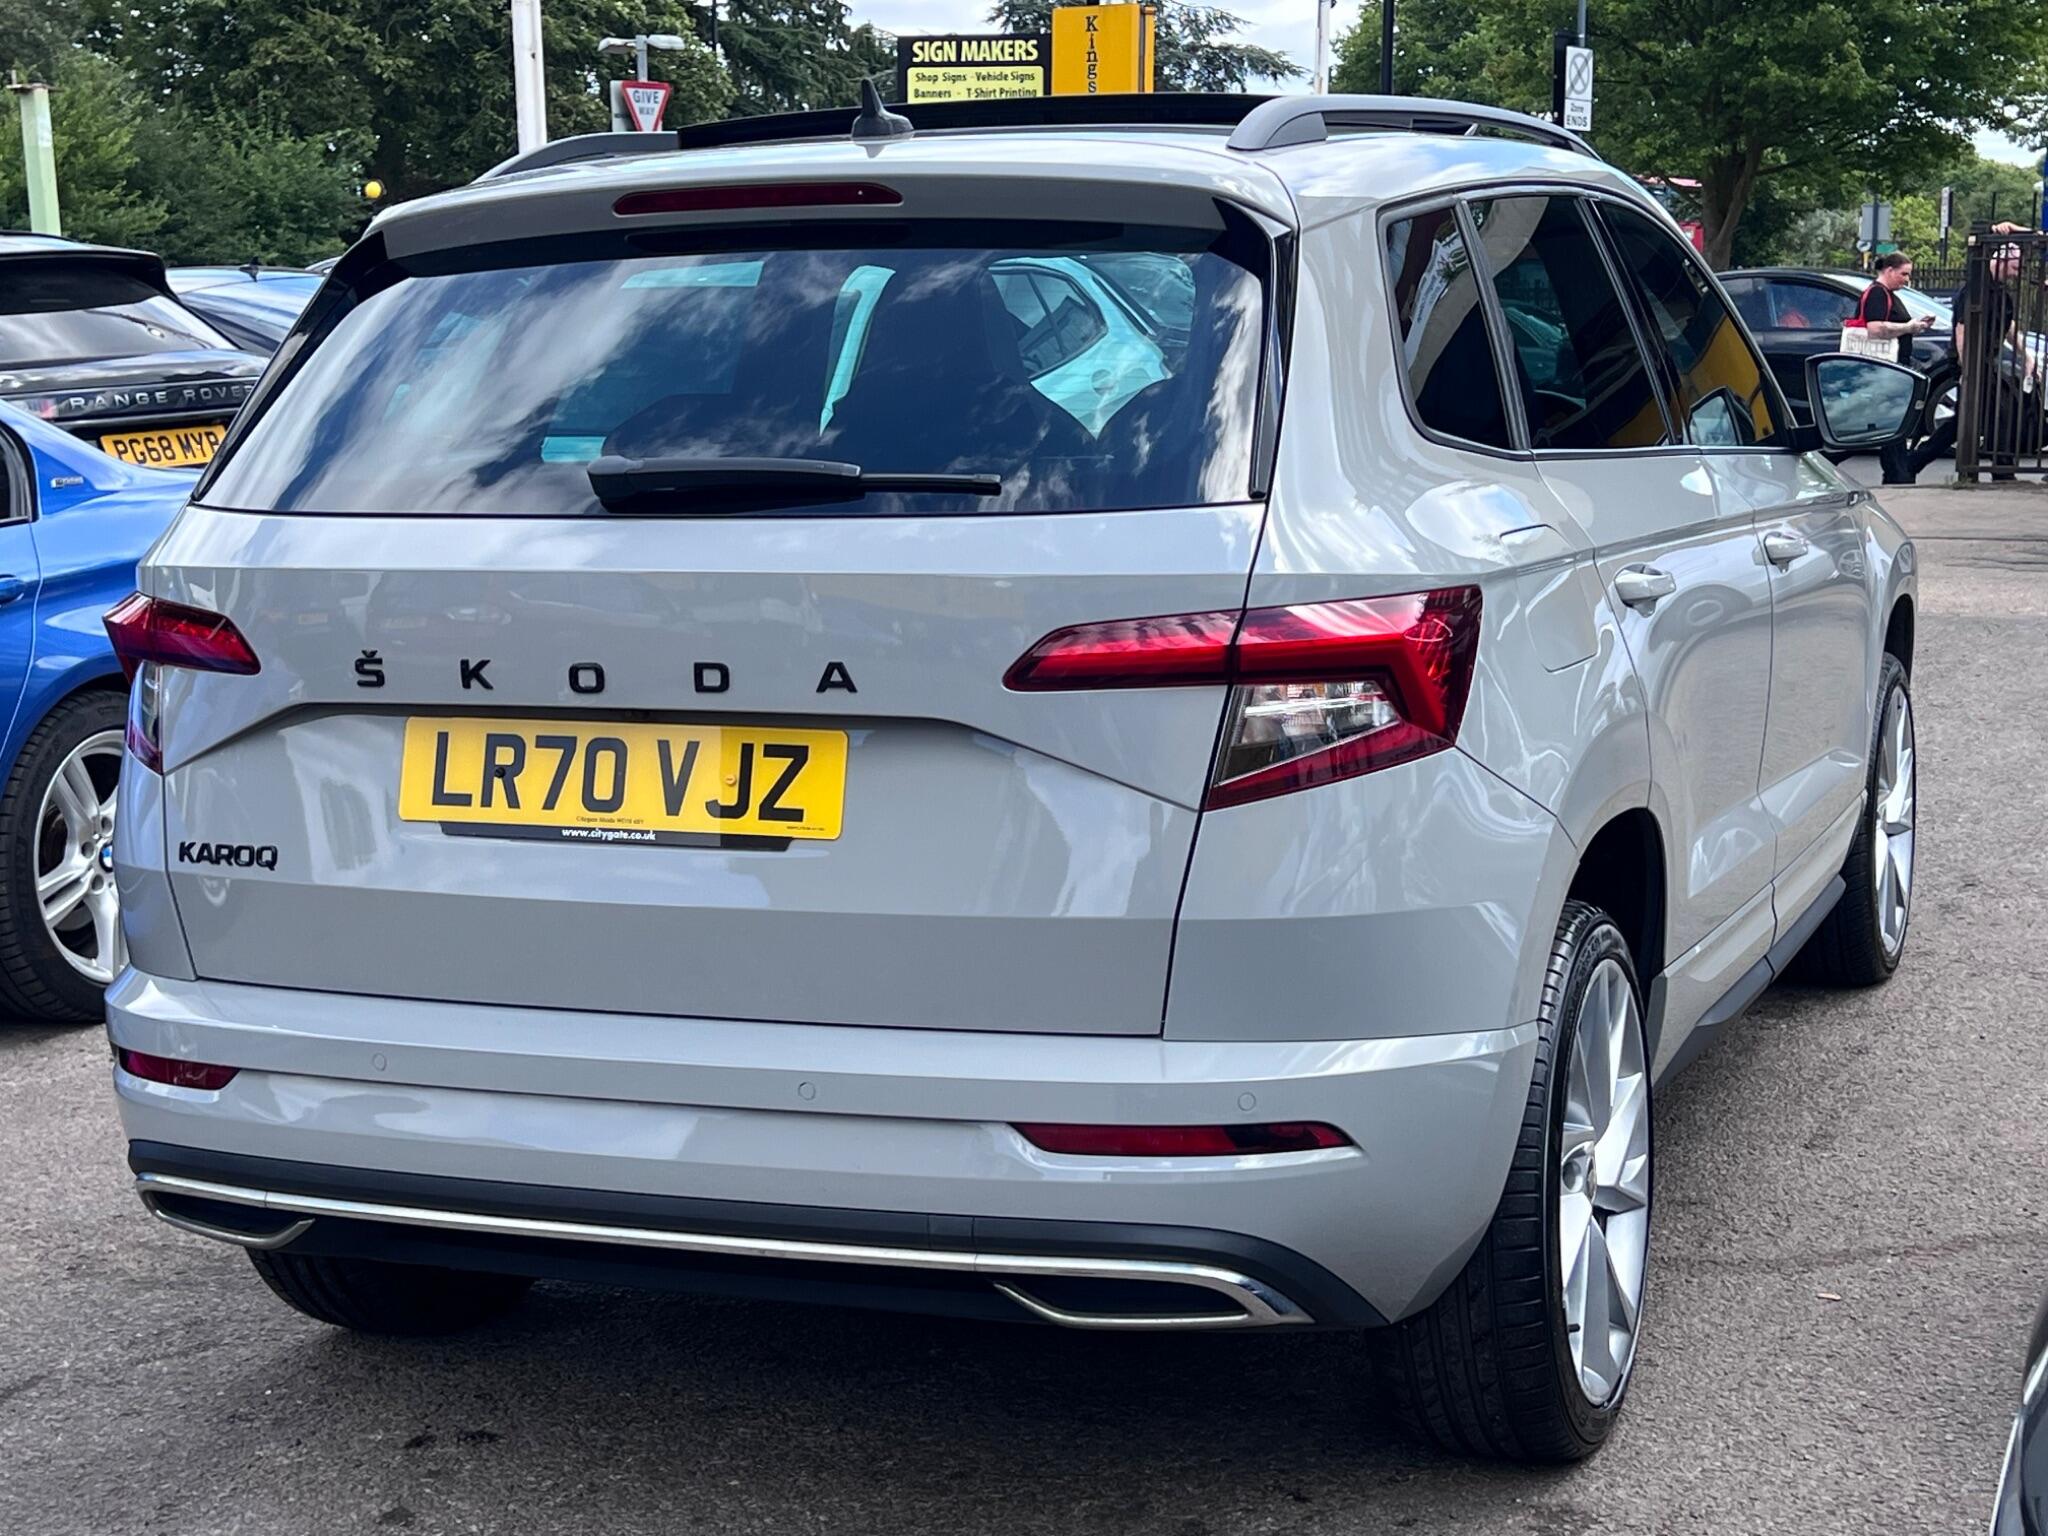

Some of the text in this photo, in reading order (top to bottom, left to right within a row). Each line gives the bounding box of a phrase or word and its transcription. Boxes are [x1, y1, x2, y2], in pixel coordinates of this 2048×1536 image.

[912, 39, 1038, 63] SIGN MAKERS
[915, 71, 1035, 84] Shop Signs Vehicle Signs
[633, 90, 659, 104] GIVE
[914, 88, 951, 98] Banners
[999, 87, 1037, 97] Printing
[638, 106, 655, 115] WAY
[1566, 115, 1588, 127] ENDS
[70, 391, 169, 410] RANGE
[112, 437, 176, 465] PG68
[354, 649, 858, 694] ŠKODA
[431, 731, 810, 823] LR70 VJZ
[561, 828, 656, 841] www.citygate.co.uk
[178, 841, 278, 871] KAROQ
